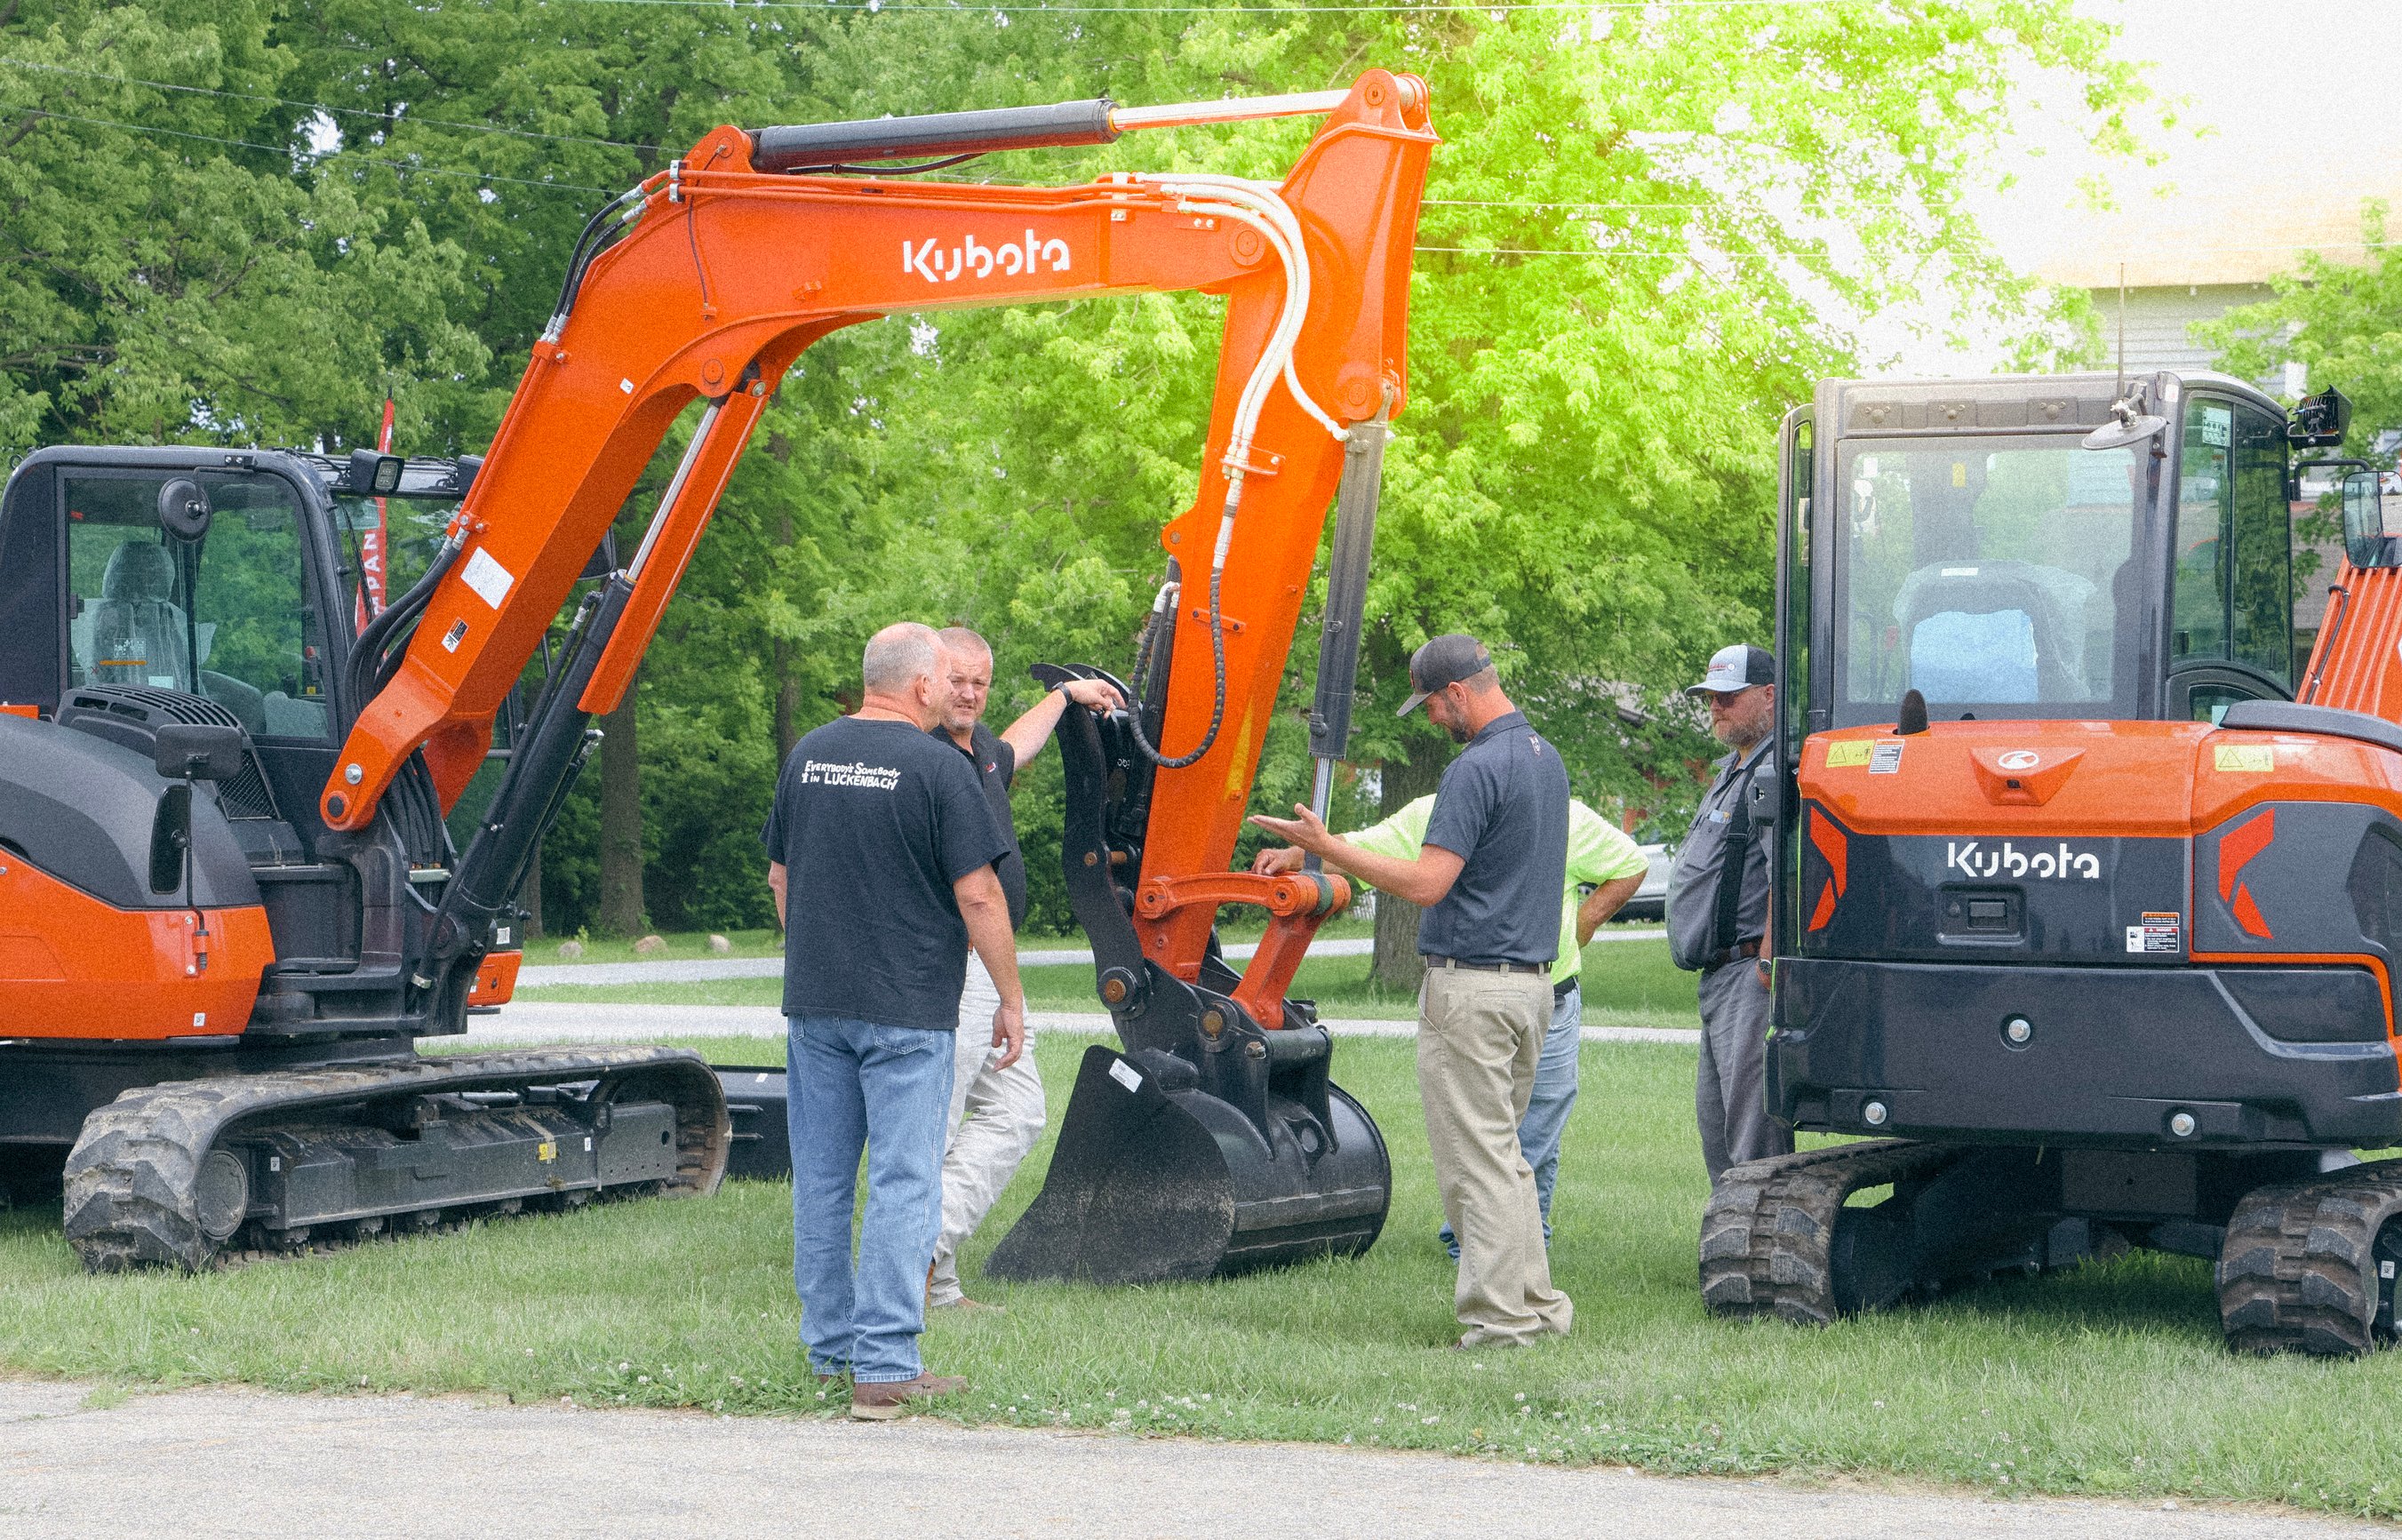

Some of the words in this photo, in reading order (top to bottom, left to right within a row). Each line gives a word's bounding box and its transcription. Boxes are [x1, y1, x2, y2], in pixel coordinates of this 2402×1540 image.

[903, 228, 1071, 283] Kubota
[824, 771, 898, 791] LUCKENBACH
[1947, 842, 2100, 879] Kubota
